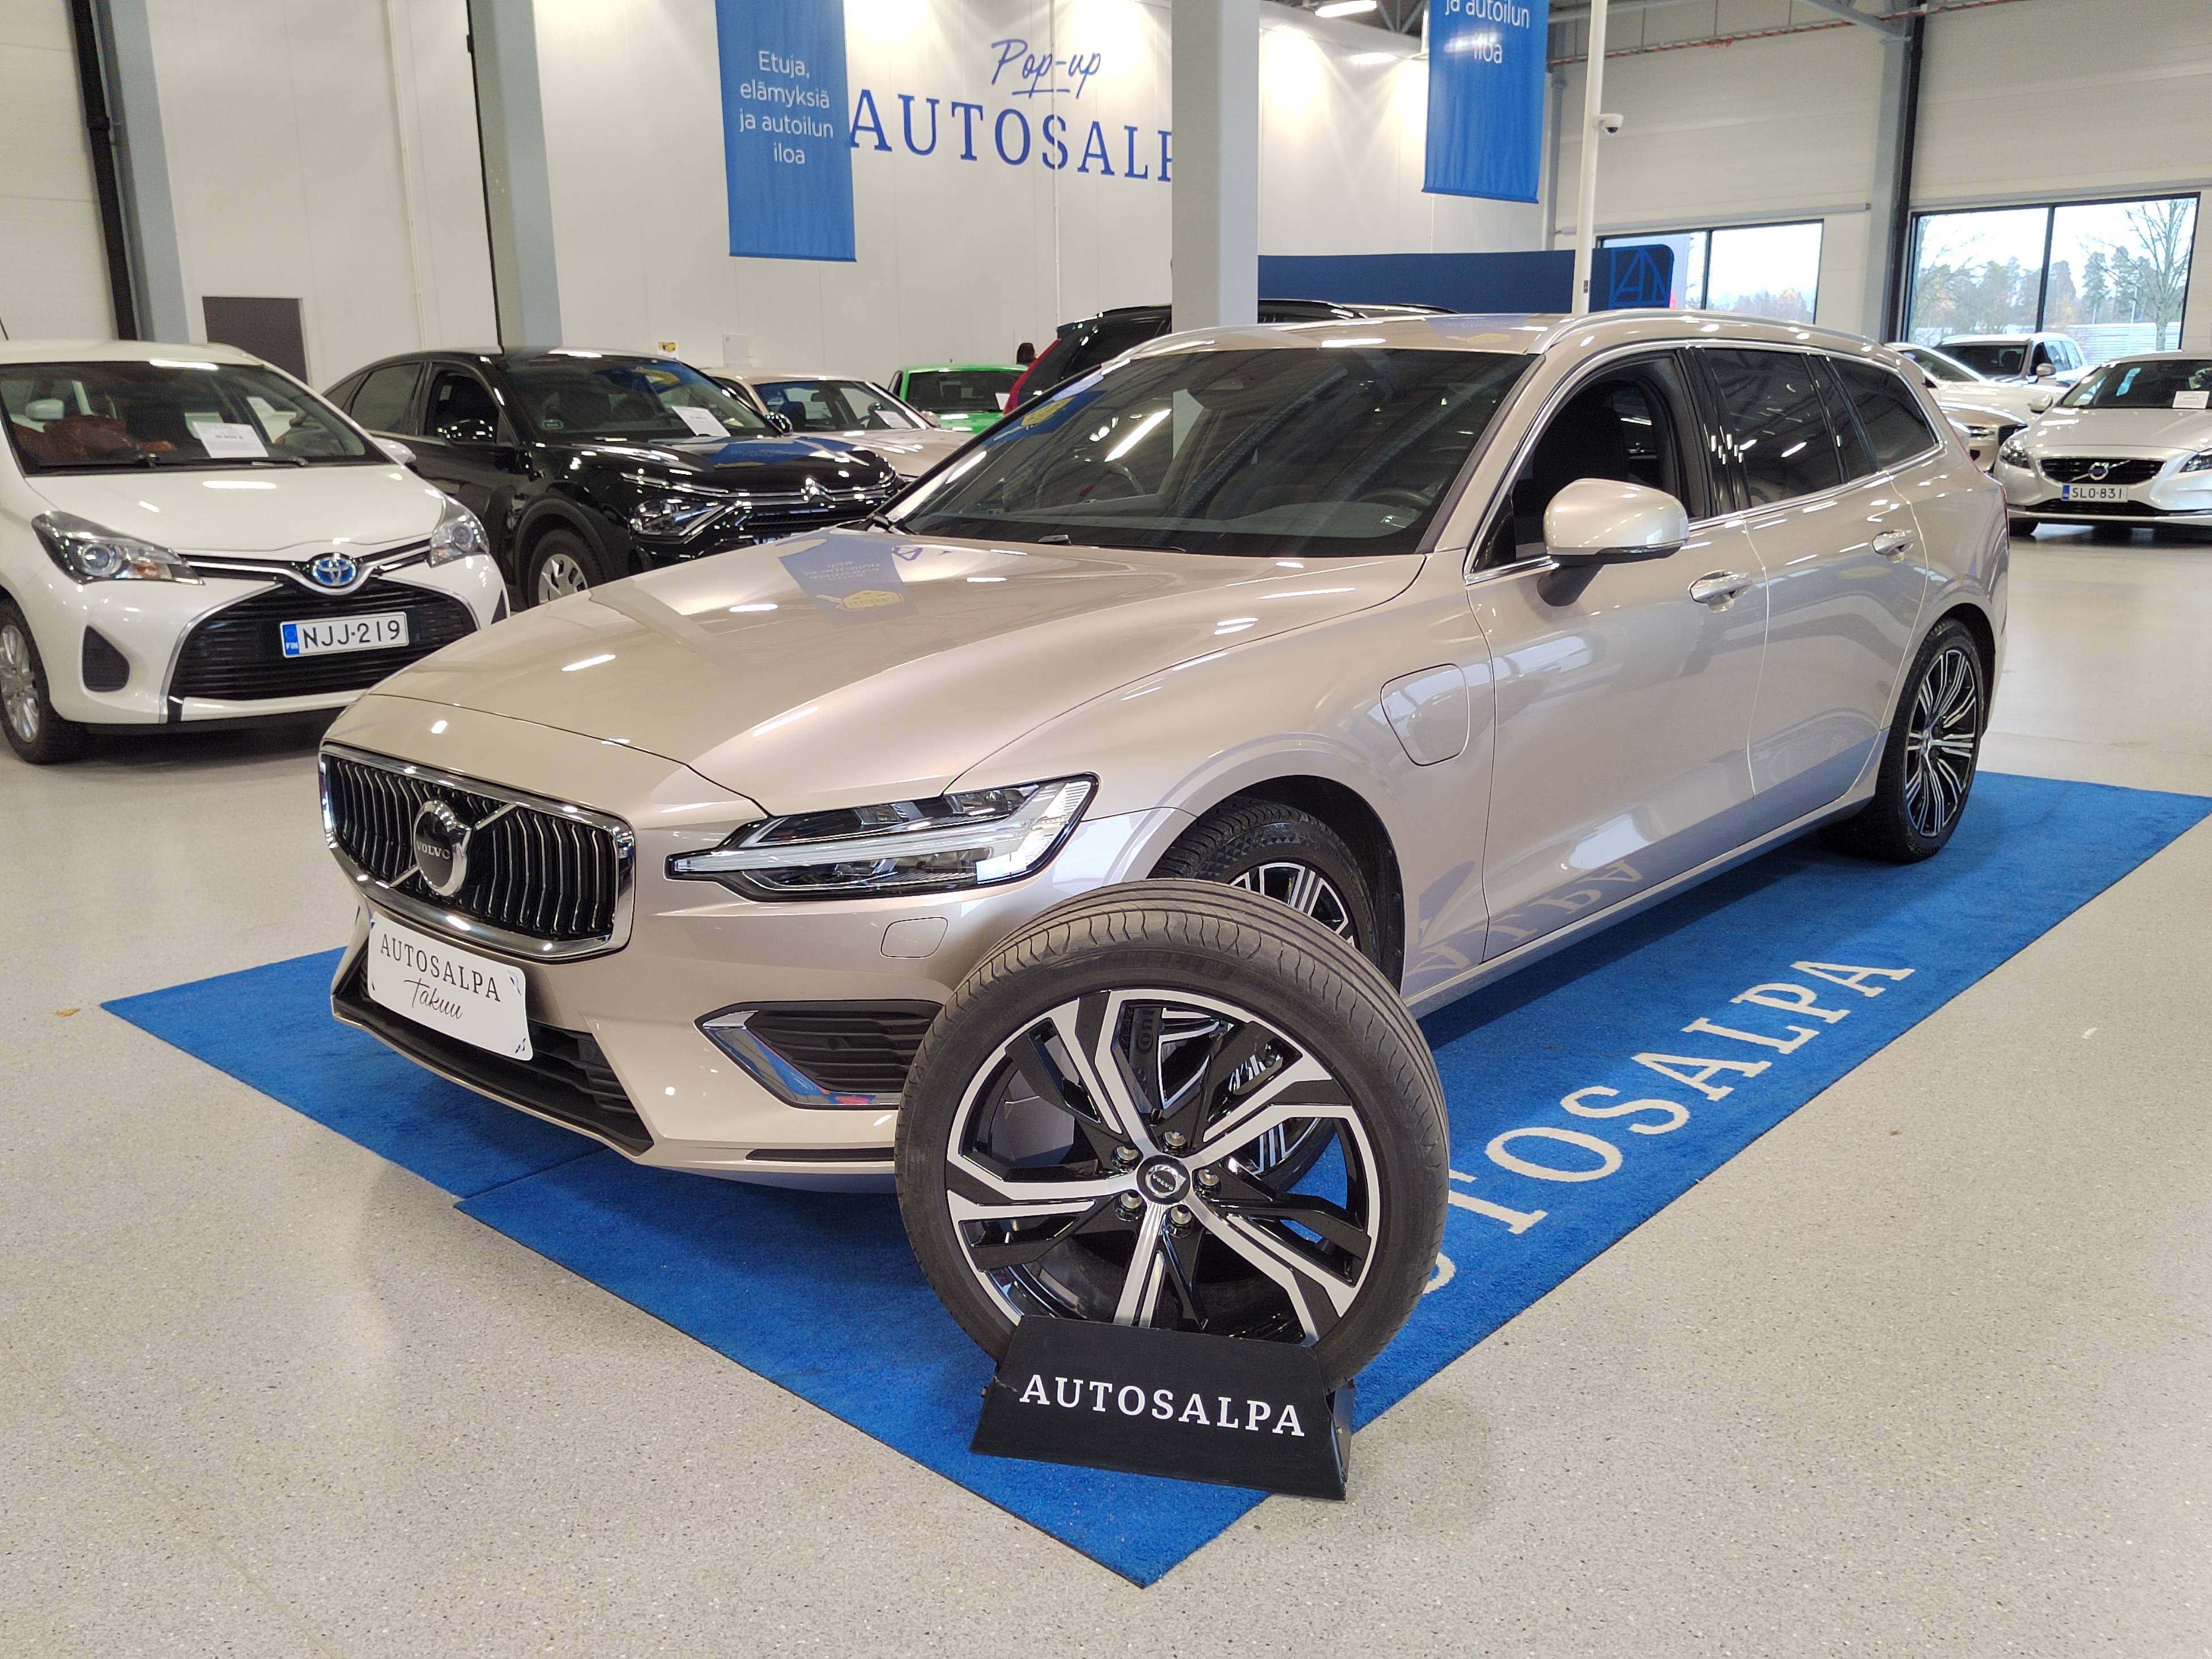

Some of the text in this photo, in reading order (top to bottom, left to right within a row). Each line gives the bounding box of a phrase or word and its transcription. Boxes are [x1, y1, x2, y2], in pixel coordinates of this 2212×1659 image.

[1465, 0, 1529, 28] autoilun
[759, 50, 810, 79] Etuja,
[991, 39, 1101, 99] Pop-up
[739, 78, 830, 108] elämyksiä
[739, 108, 833, 139] ja autoilun
[773, 142, 805, 164] iloa
[303, 620, 400, 649] NJJ-219
[416, 841, 450, 860] VOLVO
[380, 933, 501, 1002] AUTOSALPA
[403, 977, 463, 1019] Takuu
[1424, 960, 1916, 1295] TOSALPA
[1152, 1173, 1173, 1191] VOLVO
[1019, 1374, 1305, 1436] AUTOSALPA
